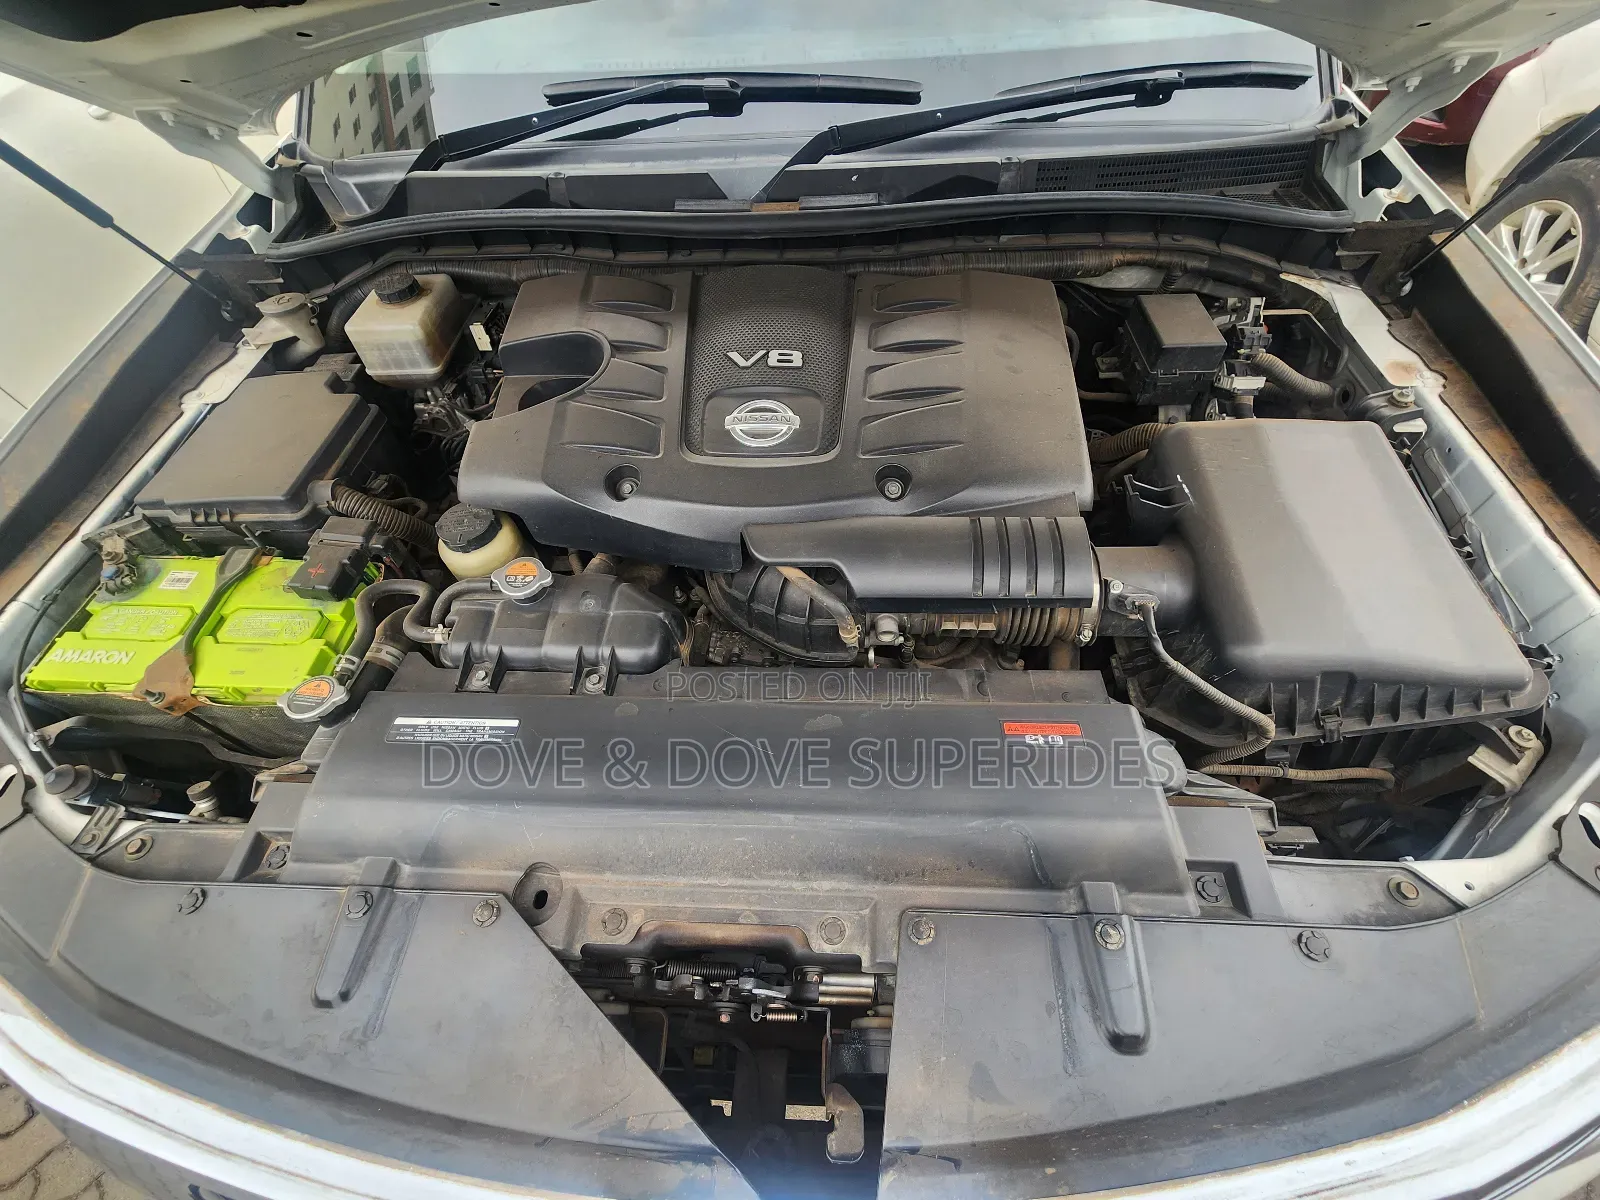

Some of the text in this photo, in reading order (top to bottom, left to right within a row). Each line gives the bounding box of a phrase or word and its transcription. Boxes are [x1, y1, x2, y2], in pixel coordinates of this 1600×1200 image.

[724, 349, 804, 368] V8
[732, 414, 792, 423] NISSAN
[46, 647, 136, 664] AMARON
